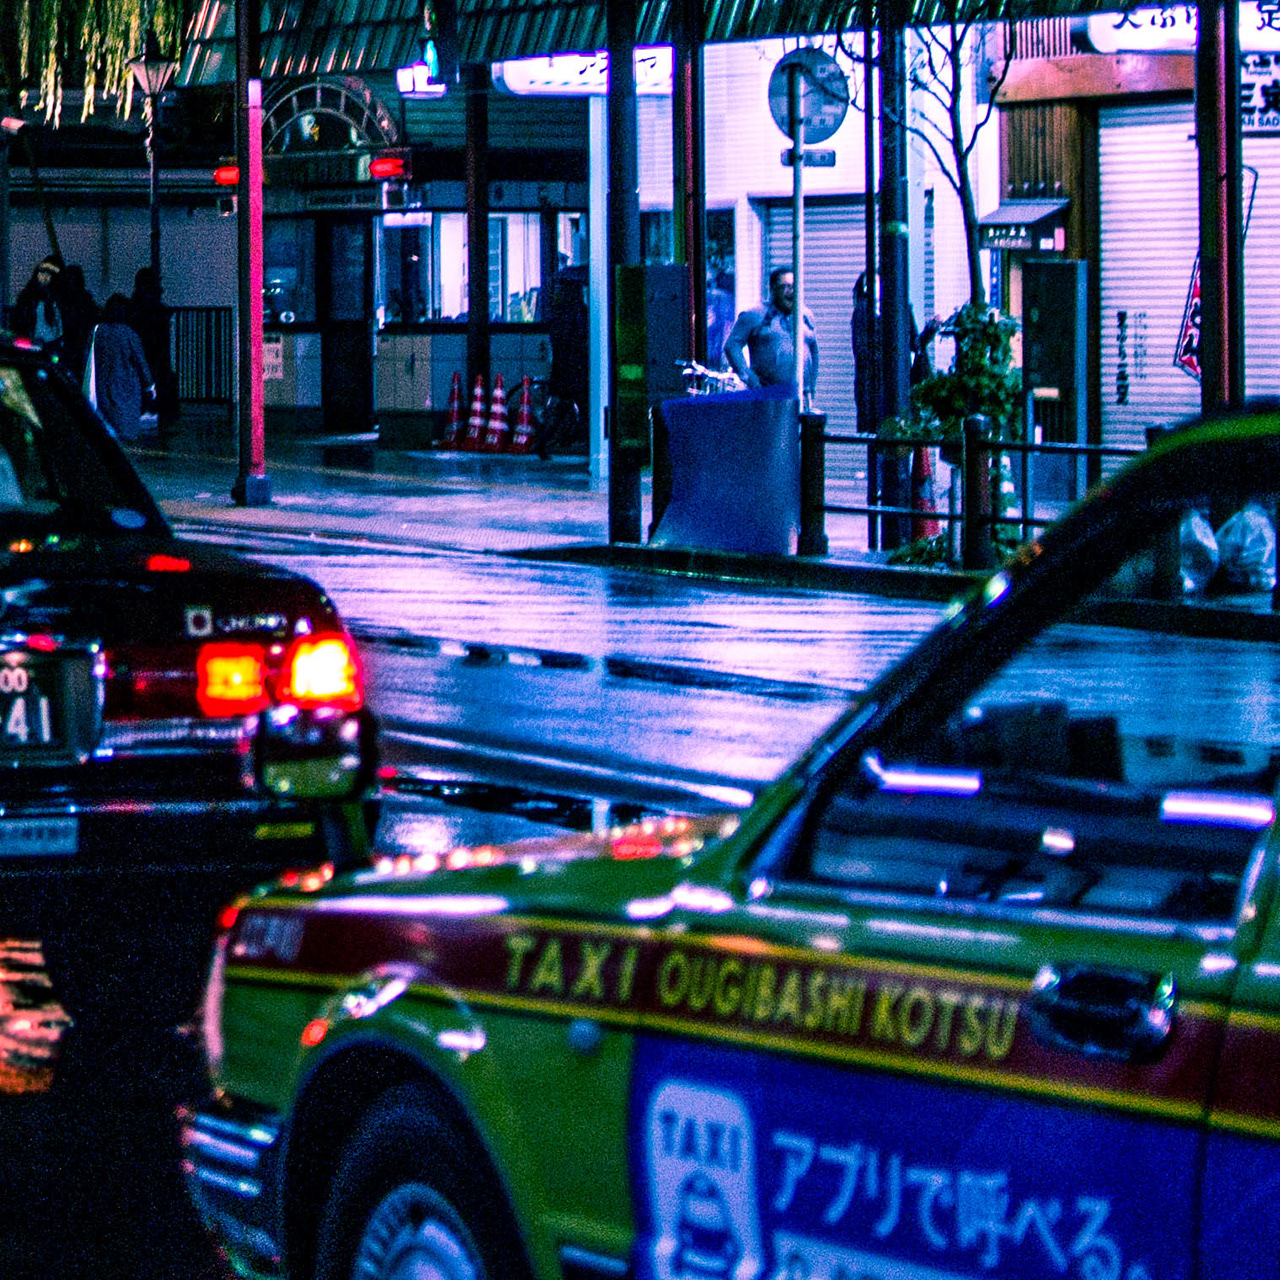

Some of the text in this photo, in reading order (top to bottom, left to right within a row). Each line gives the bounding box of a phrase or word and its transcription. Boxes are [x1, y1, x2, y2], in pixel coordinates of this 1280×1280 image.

[504, 933, 1021, 1063] TAXI OUGIBASHI KOTSU
[656, 1107, 746, 1173] TAXI
